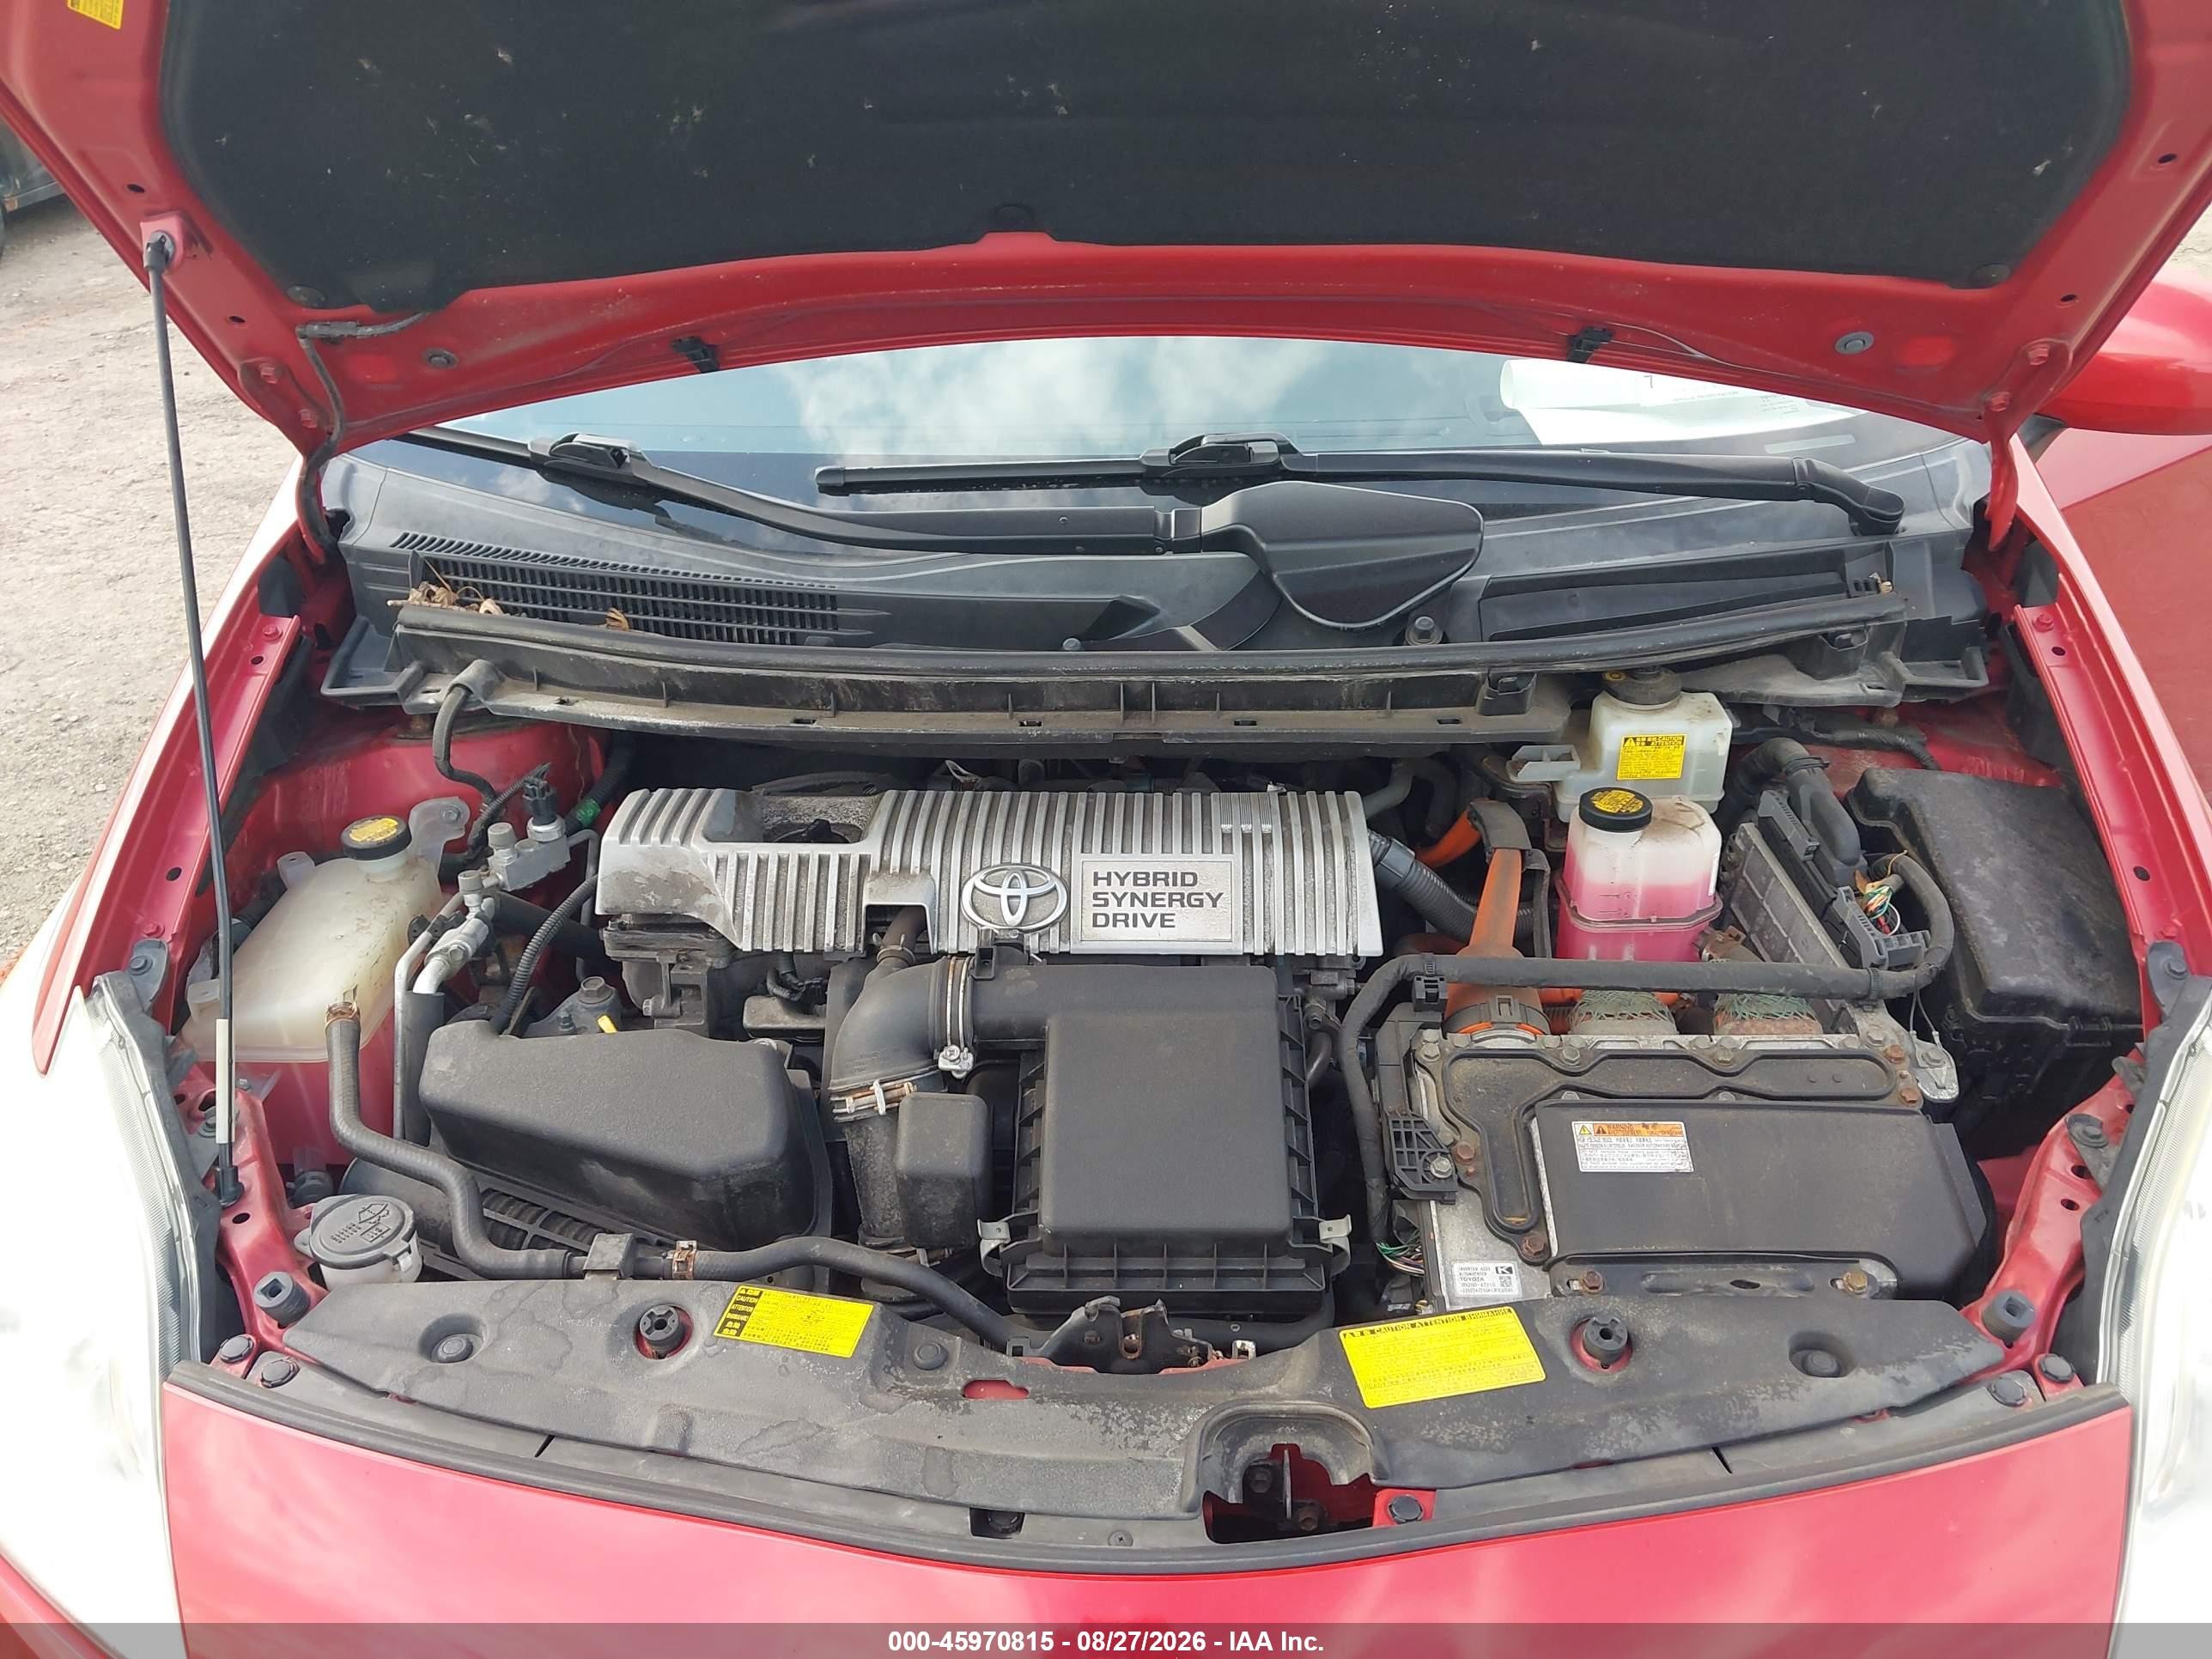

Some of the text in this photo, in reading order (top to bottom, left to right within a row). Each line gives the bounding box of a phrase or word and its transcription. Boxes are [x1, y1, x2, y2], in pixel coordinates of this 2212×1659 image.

[1092, 871, 1198, 887] HYBRID
[1092, 891, 1224, 908] SYNERGY
[1092, 913, 1176, 928] DRIVE
[736, 1295, 759, 1304] CAUTION
[1375, 1322, 1412, 1334] CAUTION
[1415, 1316, 1462, 1328] ATTENTION
